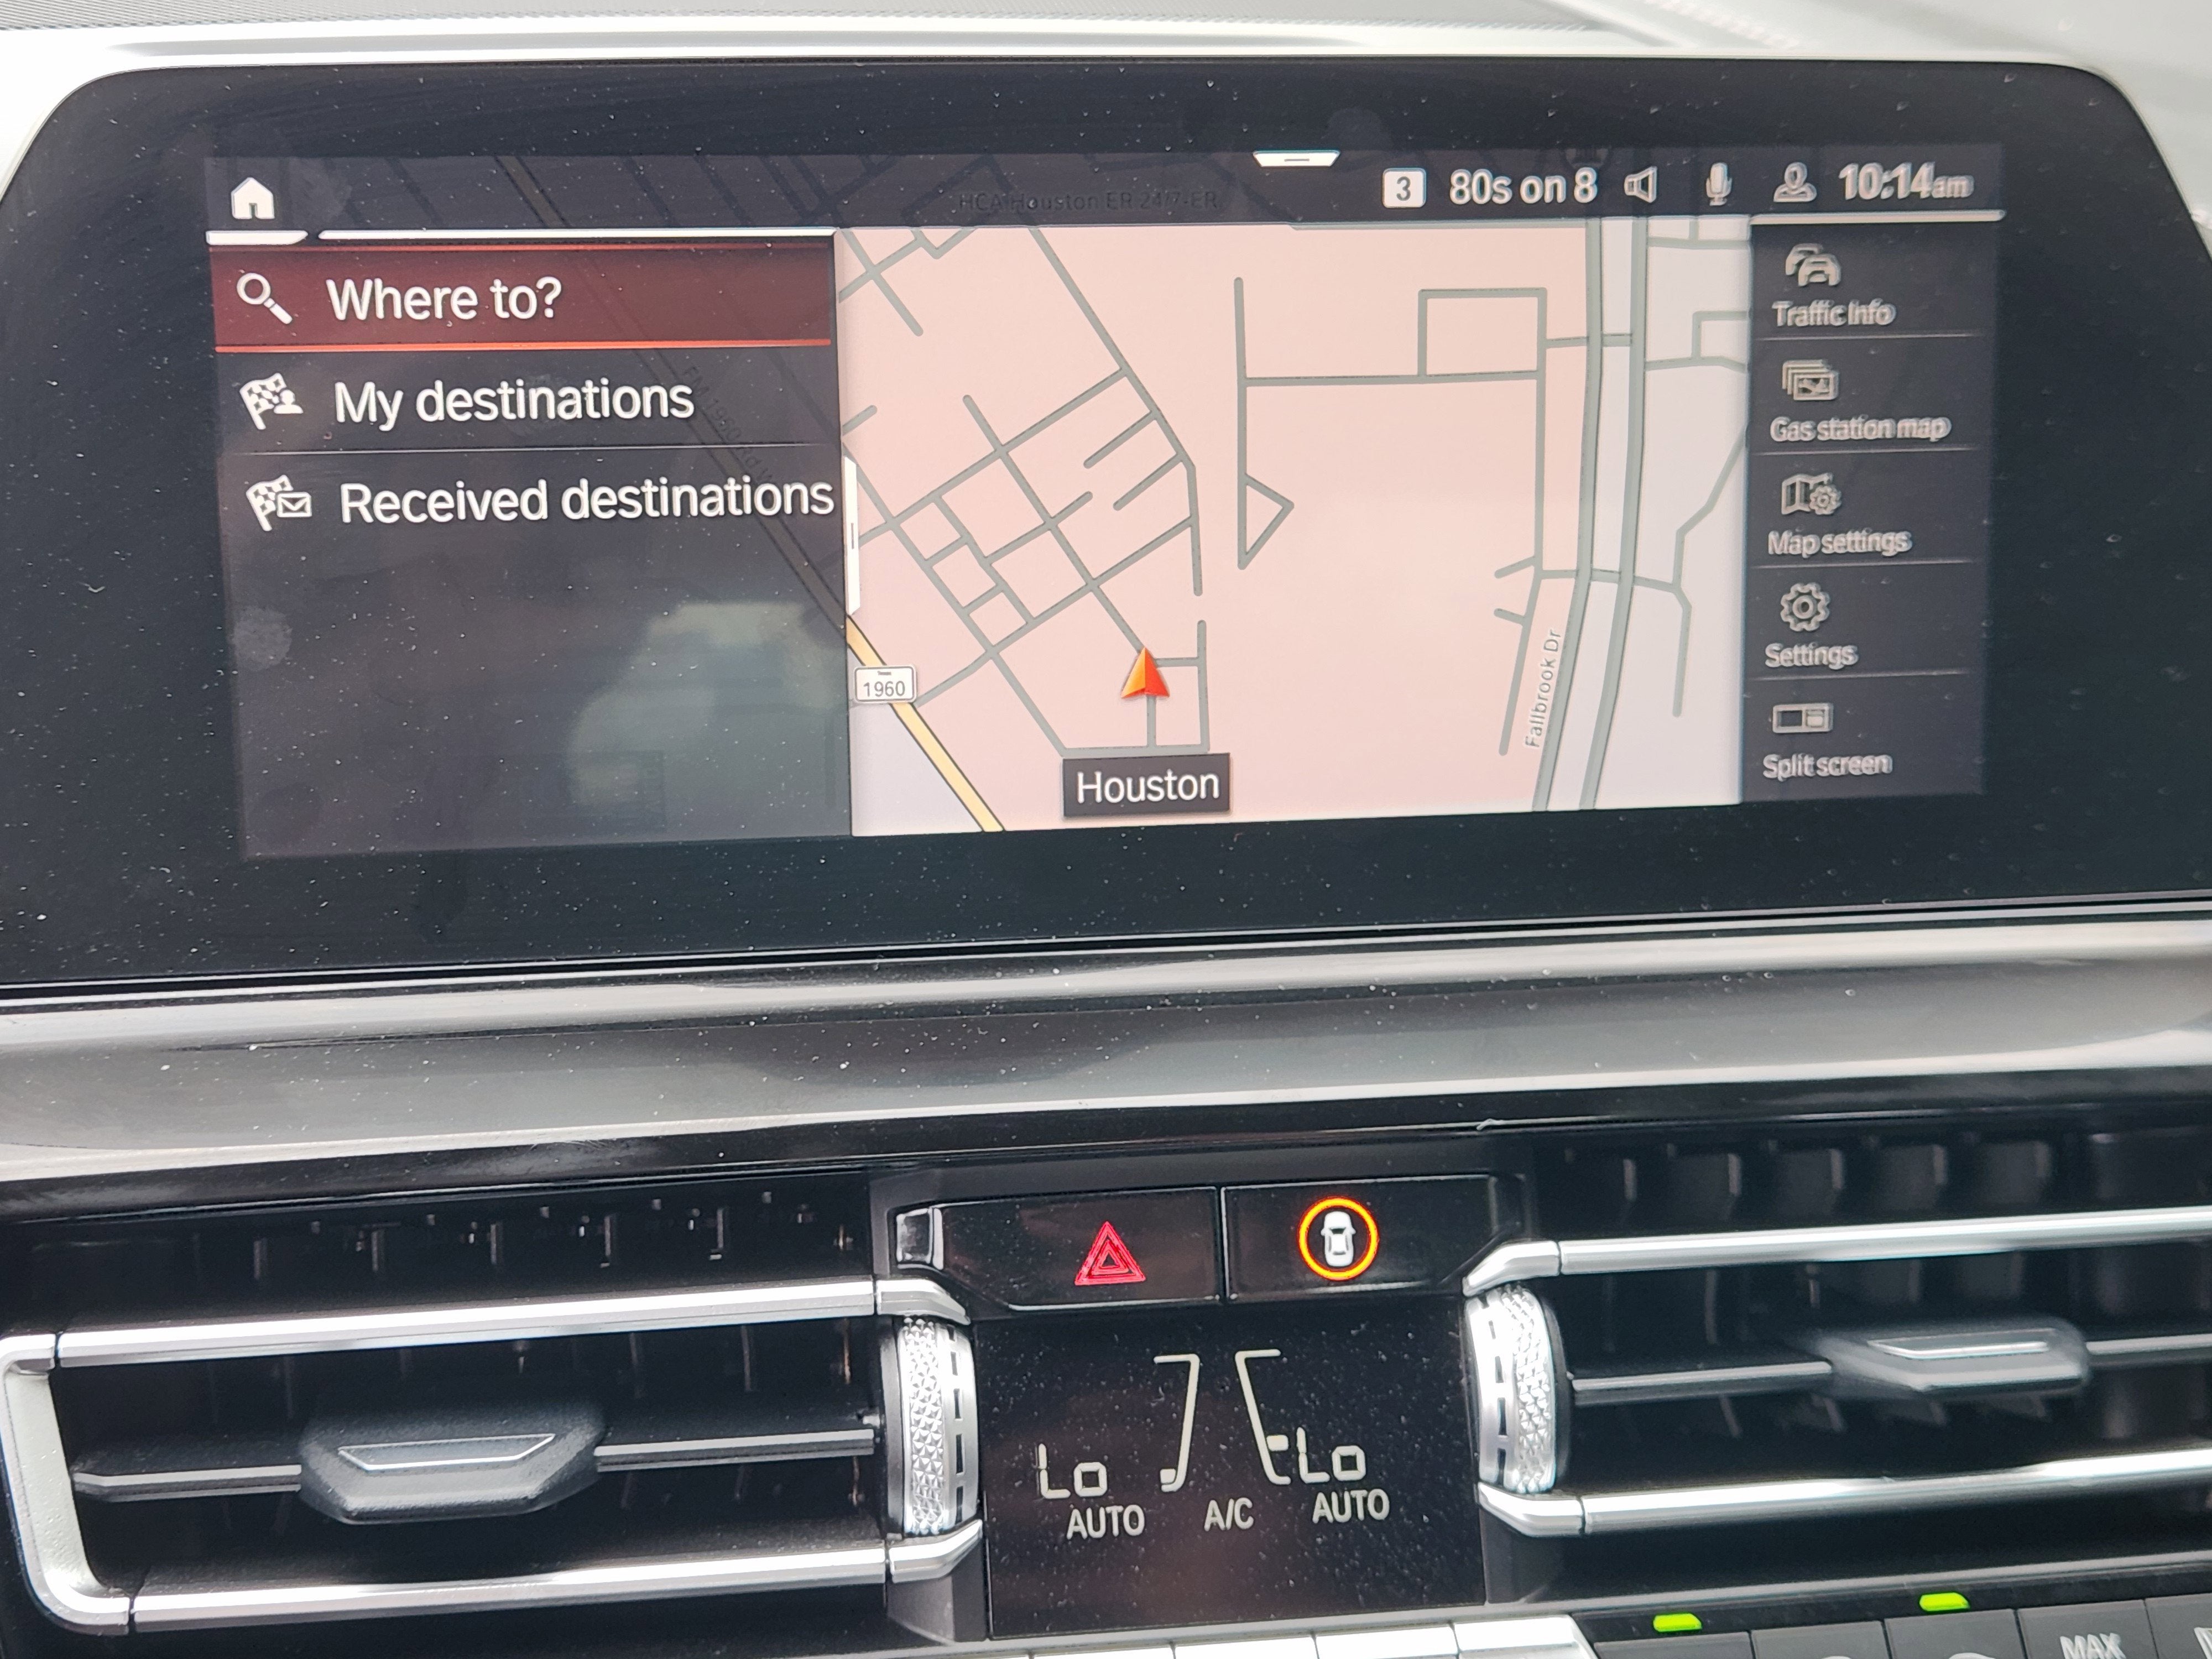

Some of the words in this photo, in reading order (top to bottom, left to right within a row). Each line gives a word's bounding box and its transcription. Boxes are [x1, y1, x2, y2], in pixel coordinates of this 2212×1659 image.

[959, 191, 1002, 211] HCA
[1009, 191, 1099, 211] Houston
[1105, 191, 1133, 210] ER
[1396, 176, 1411, 201] 3
[1449, 169, 1512, 205] 80s
[1520, 175, 1566, 204] on
[1573, 166, 1598, 203] 8
[326, 278, 478, 321] Where
[489, 276, 562, 319] to?
[1771, 300, 1846, 327] Traffic
[1848, 299, 1896, 325] Info
[335, 382, 404, 431] My
[416, 377, 695, 422] destinations
[1770, 416, 1816, 442] Gas
[1817, 415, 1897, 441] station
[1896, 417, 1952, 442] map
[340, 479, 548, 524] Received
[561, 474, 834, 520] destinations
[1768, 530, 1821, 559] Map
[1820, 528, 1912, 557] settings
[1765, 642, 1859, 670] Settings
[864, 681, 905, 697] 1960
[1525, 658, 1557, 747] Fallbrook
[1543, 629, 1561, 652] Dr
[1762, 753, 1815, 782] Split
[1816, 754, 1893, 776] screen
[1077, 769, 1219, 804] Houston
[1067, 1504, 1145, 1539] AUTO
[1204, 1497, 1254, 1531] A/C
[1312, 1489, 1389, 1524] AUTO
[2059, 1632, 2126, 1659] MAX
